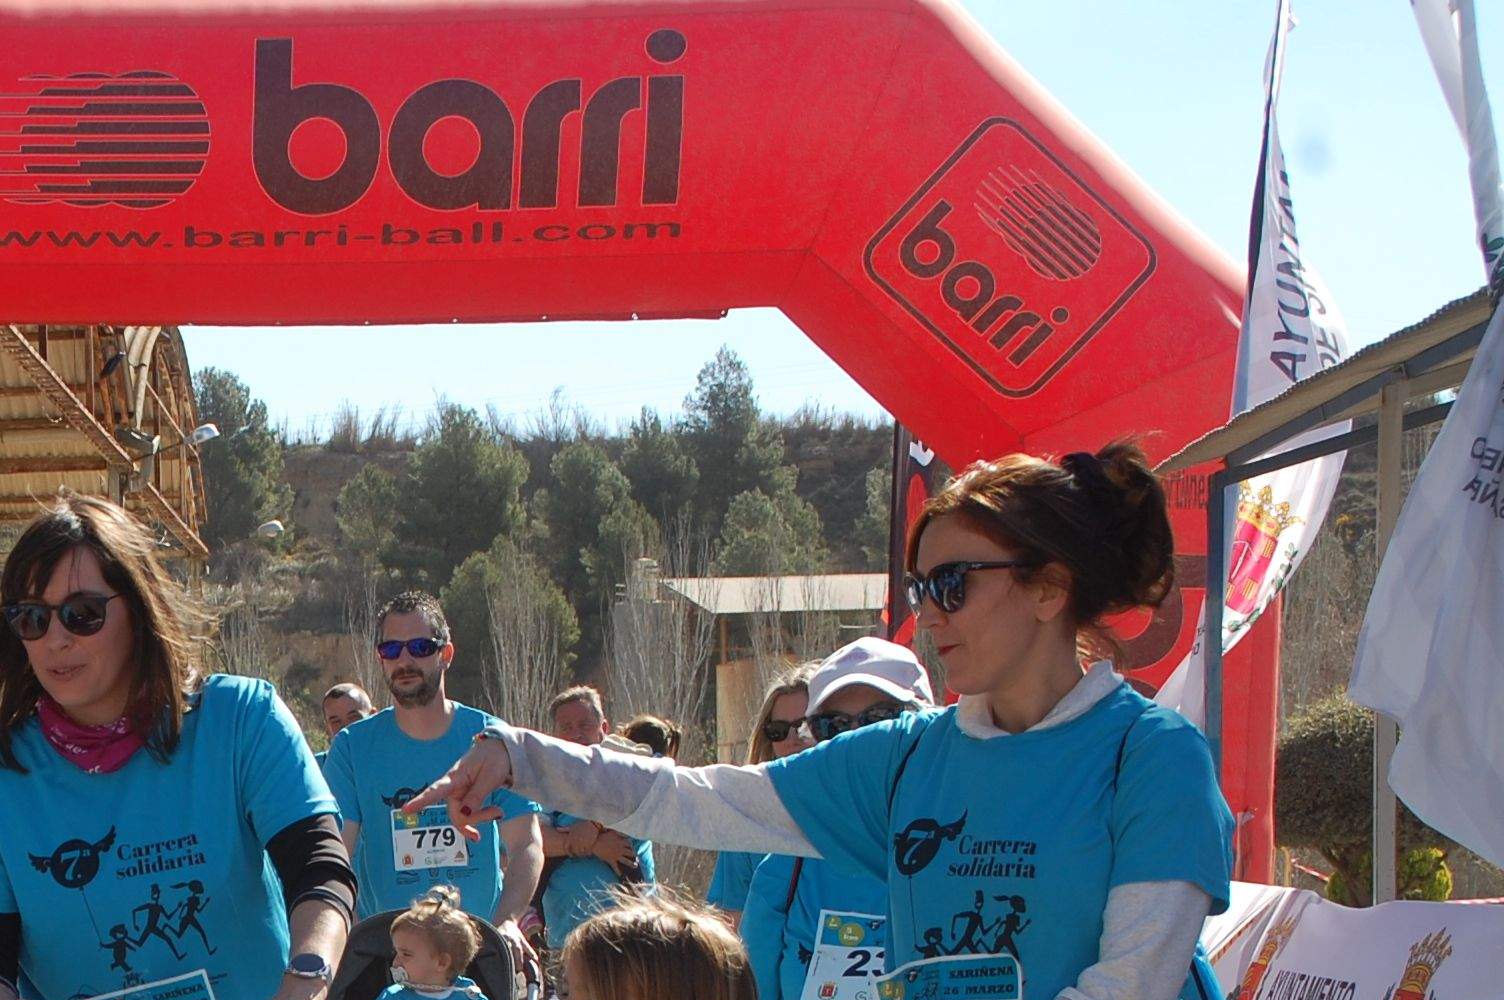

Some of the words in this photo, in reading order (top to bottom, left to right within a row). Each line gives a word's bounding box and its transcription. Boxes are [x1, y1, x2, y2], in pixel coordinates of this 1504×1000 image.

[252, 28, 688, 216] barri
[899, 200, 1069, 368] barri
[116, 833, 198, 861] Carrera
[412, 827, 456, 849] 779
[959, 834, 1036, 856] Carrera
[116, 849, 206, 880] solidaria
[948, 857, 1036, 879] solidaria
[949, 965, 1014, 979] SARIÑENA
[944, 986, 959, 996] 26
[965, 984, 1014, 995] MARZO
